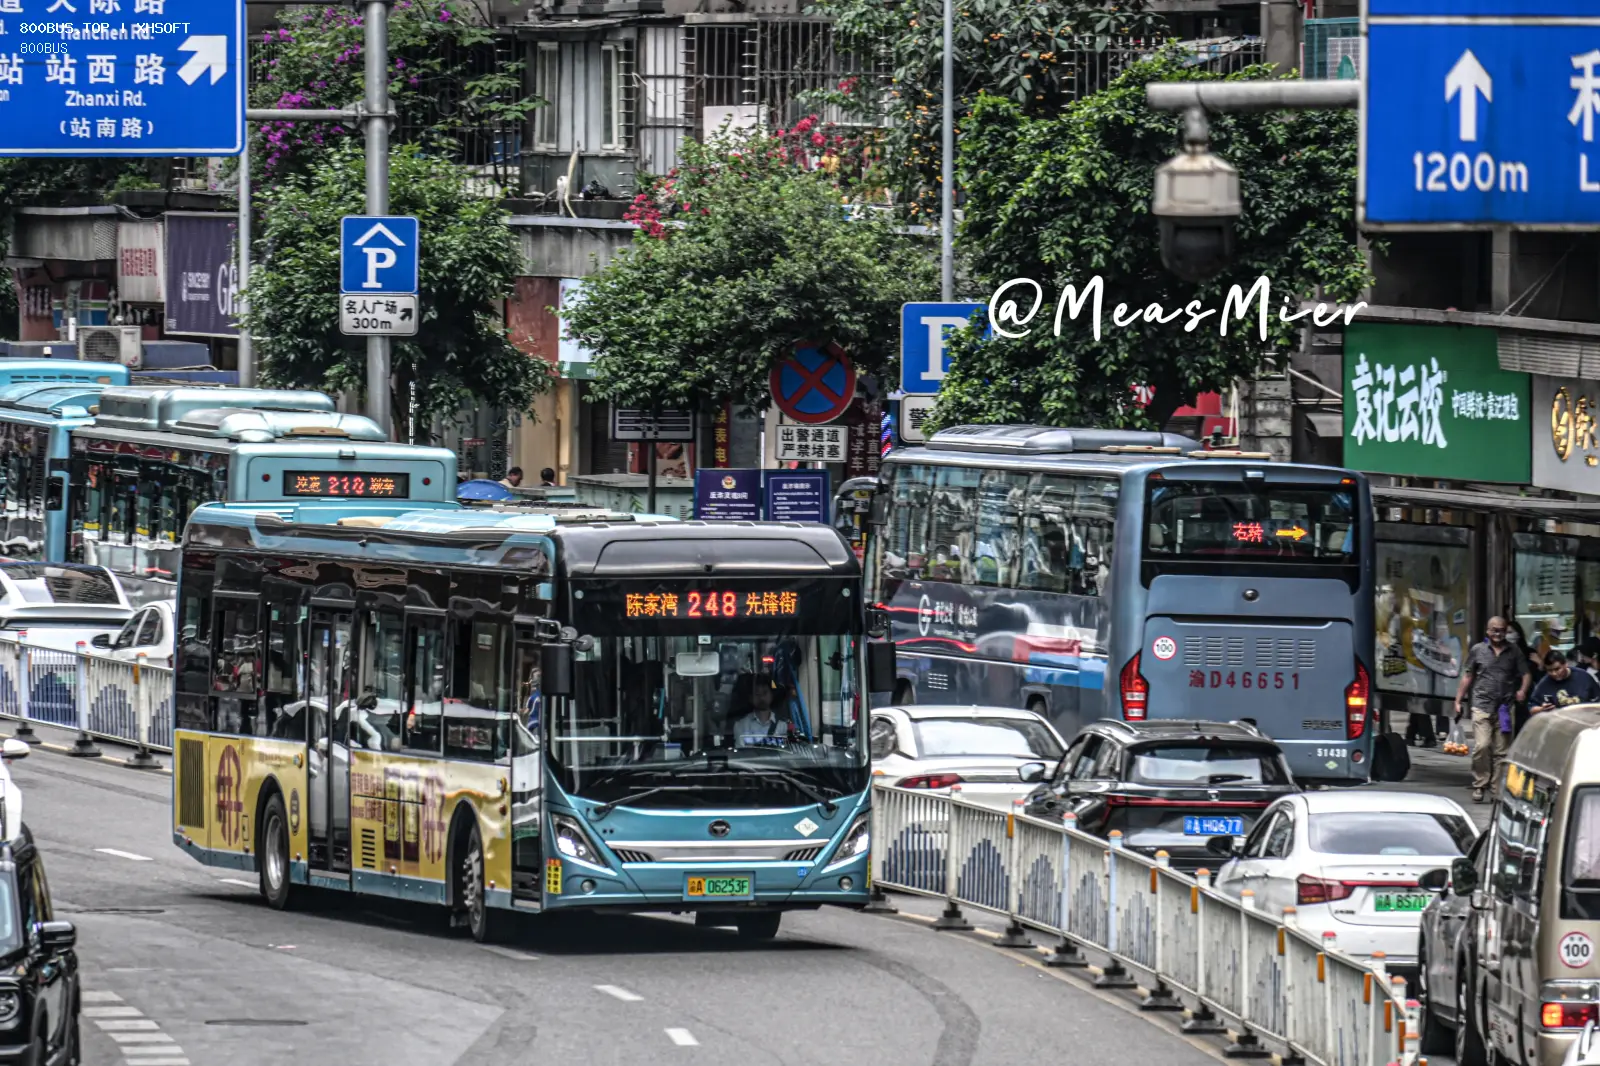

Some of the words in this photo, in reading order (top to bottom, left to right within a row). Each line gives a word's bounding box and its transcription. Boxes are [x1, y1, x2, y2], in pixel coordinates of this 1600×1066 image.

[45, 53, 166, 85] 站西路
[65, 90, 119, 107] Zhanxi
[123, 91, 147, 107] Rd.
[1413, 151, 1528, 193] 1200m
[362, 247, 397, 288] P
[345, 299, 398, 315] 名人广场
[352, 318, 392, 330] 300m
[1351, 352, 1448, 449] 袁记云饺
[781, 428, 841, 443] 出警通道
[781, 443, 841, 459] 严禁堵塞
[626, 593, 678, 617] 陈家湾
[687, 591, 736, 617] 248
[746, 591, 798, 615] 先锋街
[1156, 643, 1174, 653] 100
[1188, 669, 1300, 690] 渝D46651
[707, 879, 749, 893] 06253F
[1563, 943, 1590, 958] 100
